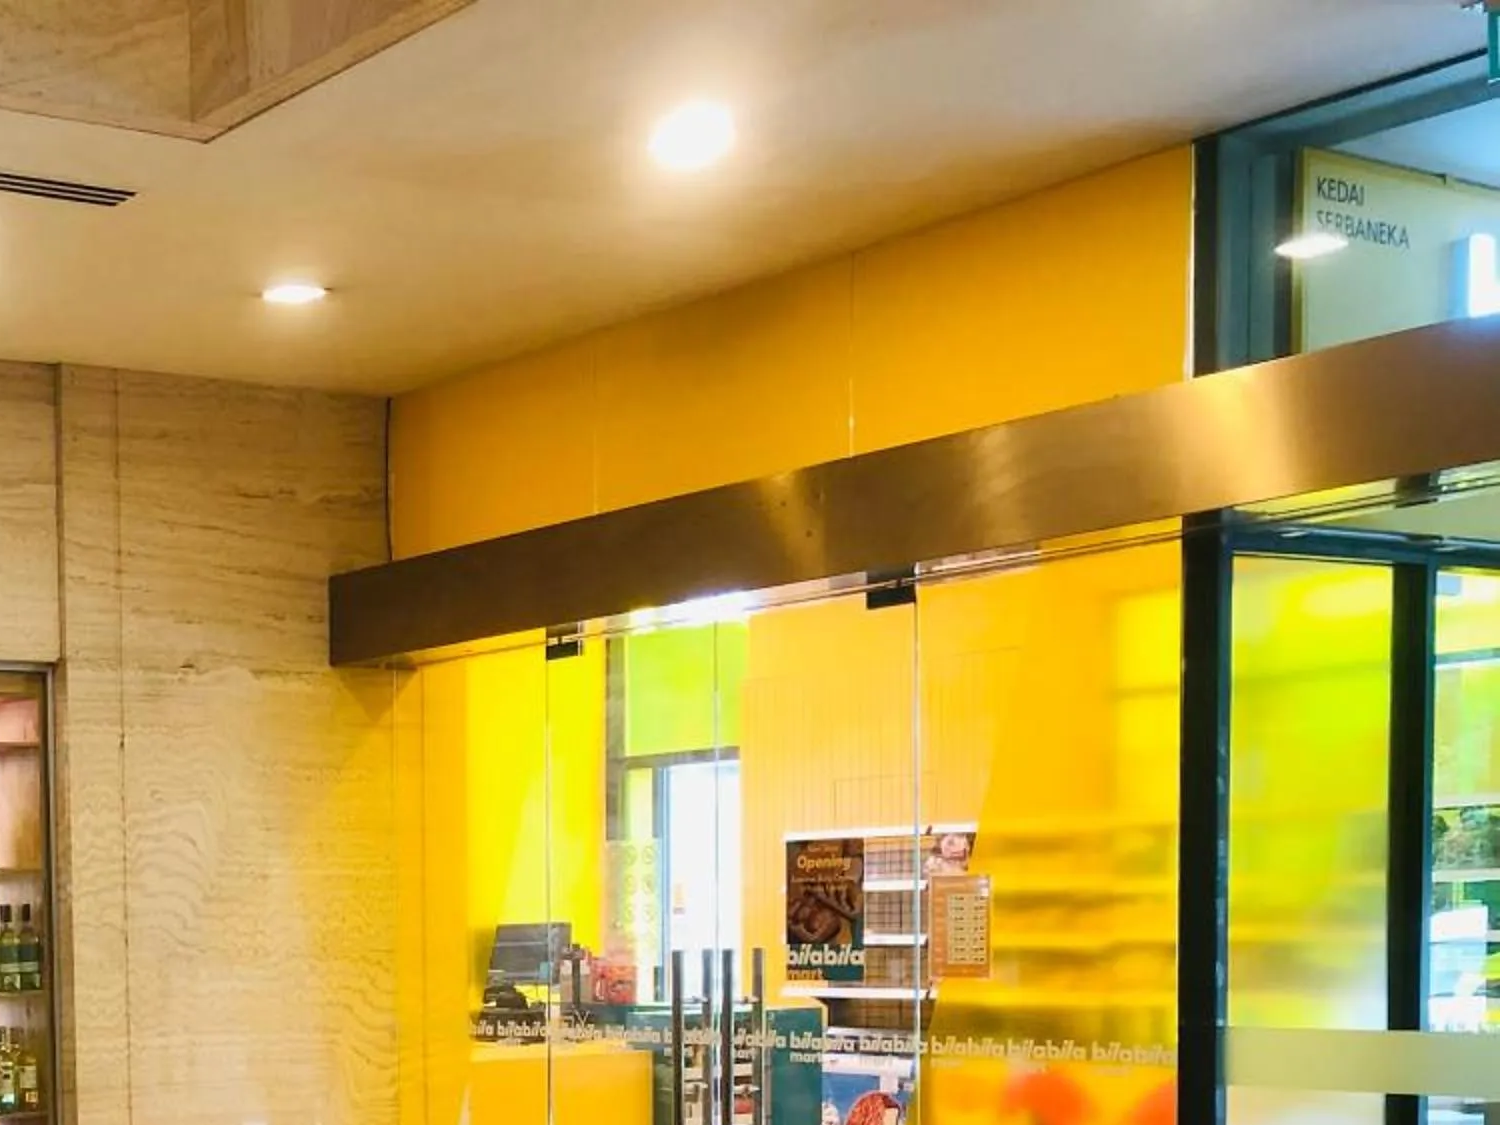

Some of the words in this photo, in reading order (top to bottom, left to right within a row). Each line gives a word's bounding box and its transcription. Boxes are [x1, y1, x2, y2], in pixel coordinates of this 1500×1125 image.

[1316, 175, 1366, 207] KEDAI
[797, 855, 852, 874] Opening
[787, 943, 864, 965] bilabila
[860, 1034, 929, 1053] bilabila
[931, 1035, 1005, 1058] bilabila
[1007, 1038, 1087, 1061] bilabila
[1092, 1041, 1177, 1066] bilabila
